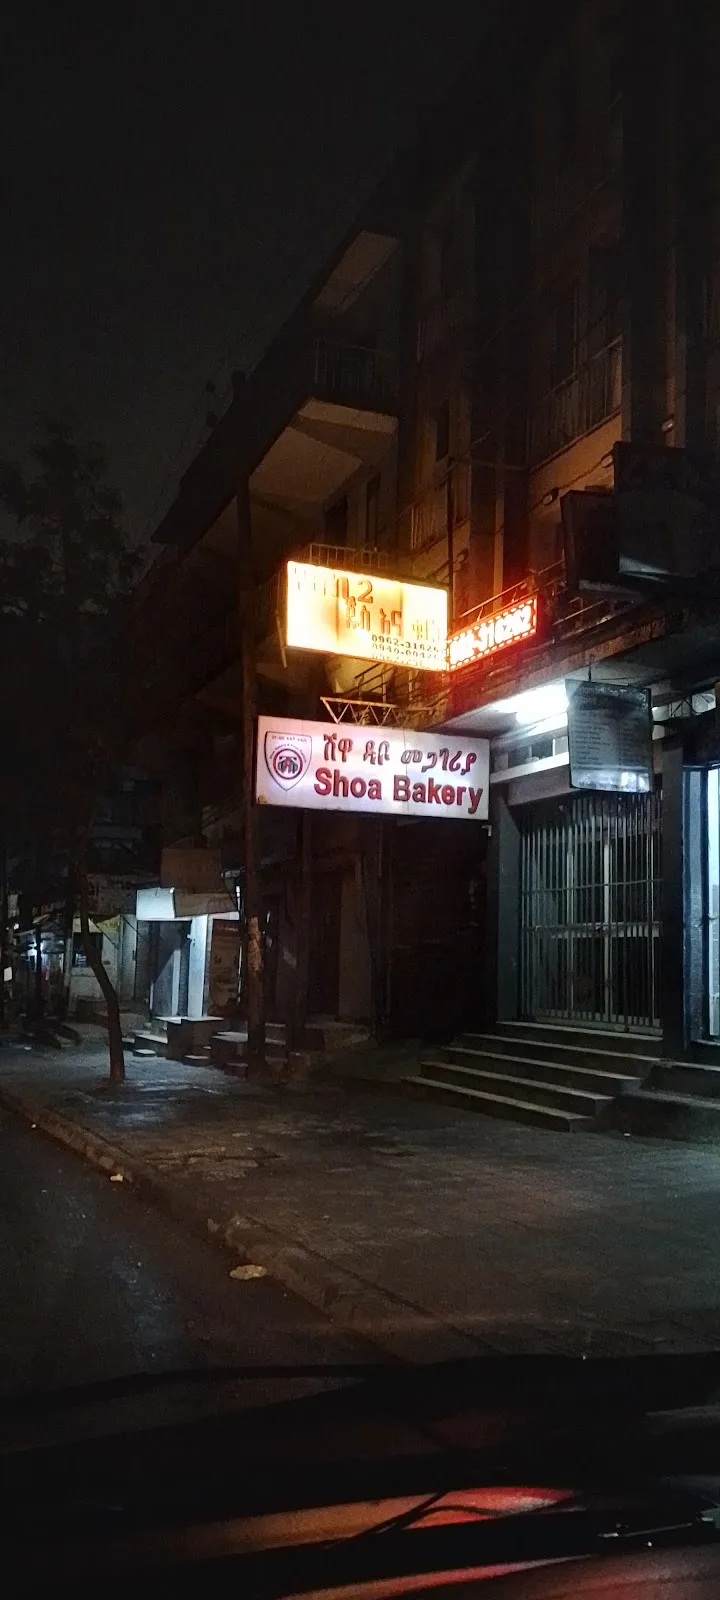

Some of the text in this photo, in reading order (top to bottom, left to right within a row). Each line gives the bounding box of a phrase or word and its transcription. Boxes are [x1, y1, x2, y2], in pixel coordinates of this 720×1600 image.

[357, 579, 374, 604] 2
[323, 732, 353, 762] ሸዋ
[363, 739, 390, 766] ዳቦ
[400, 748, 477, 776] መጋገሪያ
[314, 767, 484, 815] Shoa Bakery
